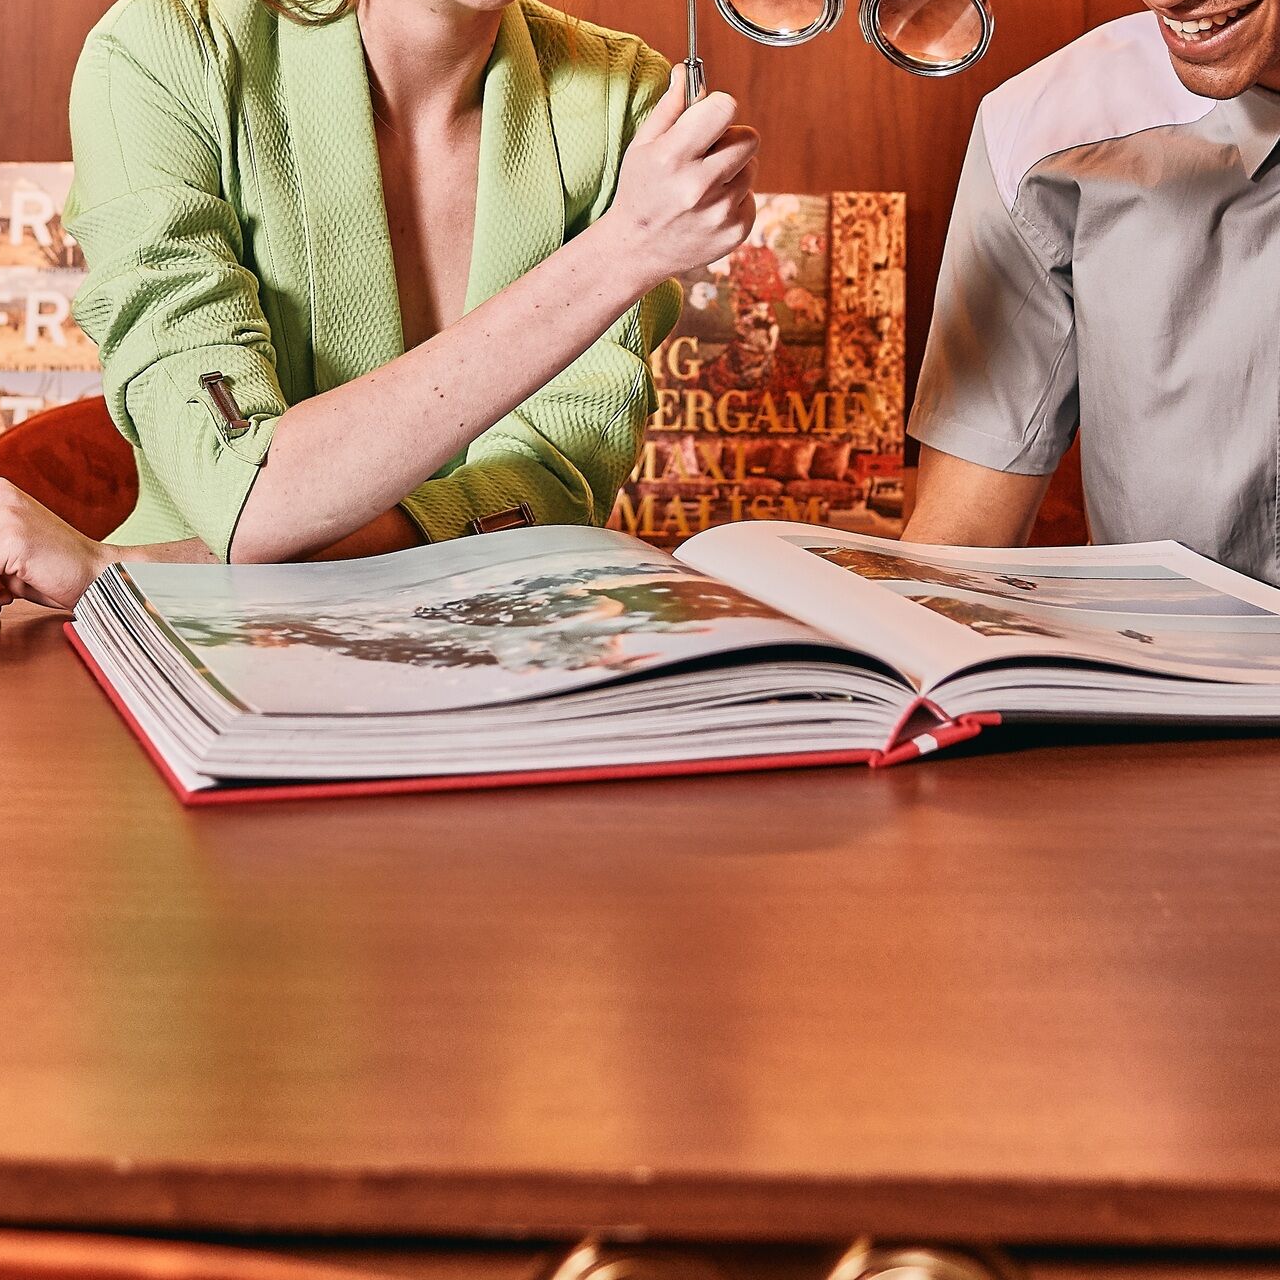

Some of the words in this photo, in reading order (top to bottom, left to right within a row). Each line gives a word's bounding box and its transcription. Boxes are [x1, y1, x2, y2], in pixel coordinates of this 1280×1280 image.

[649, 335, 704, 381] IG
[649, 390, 888, 434] ERGAMIN
[631, 441, 766, 484] MAXI-
[616, 494, 825, 538] MALISM
